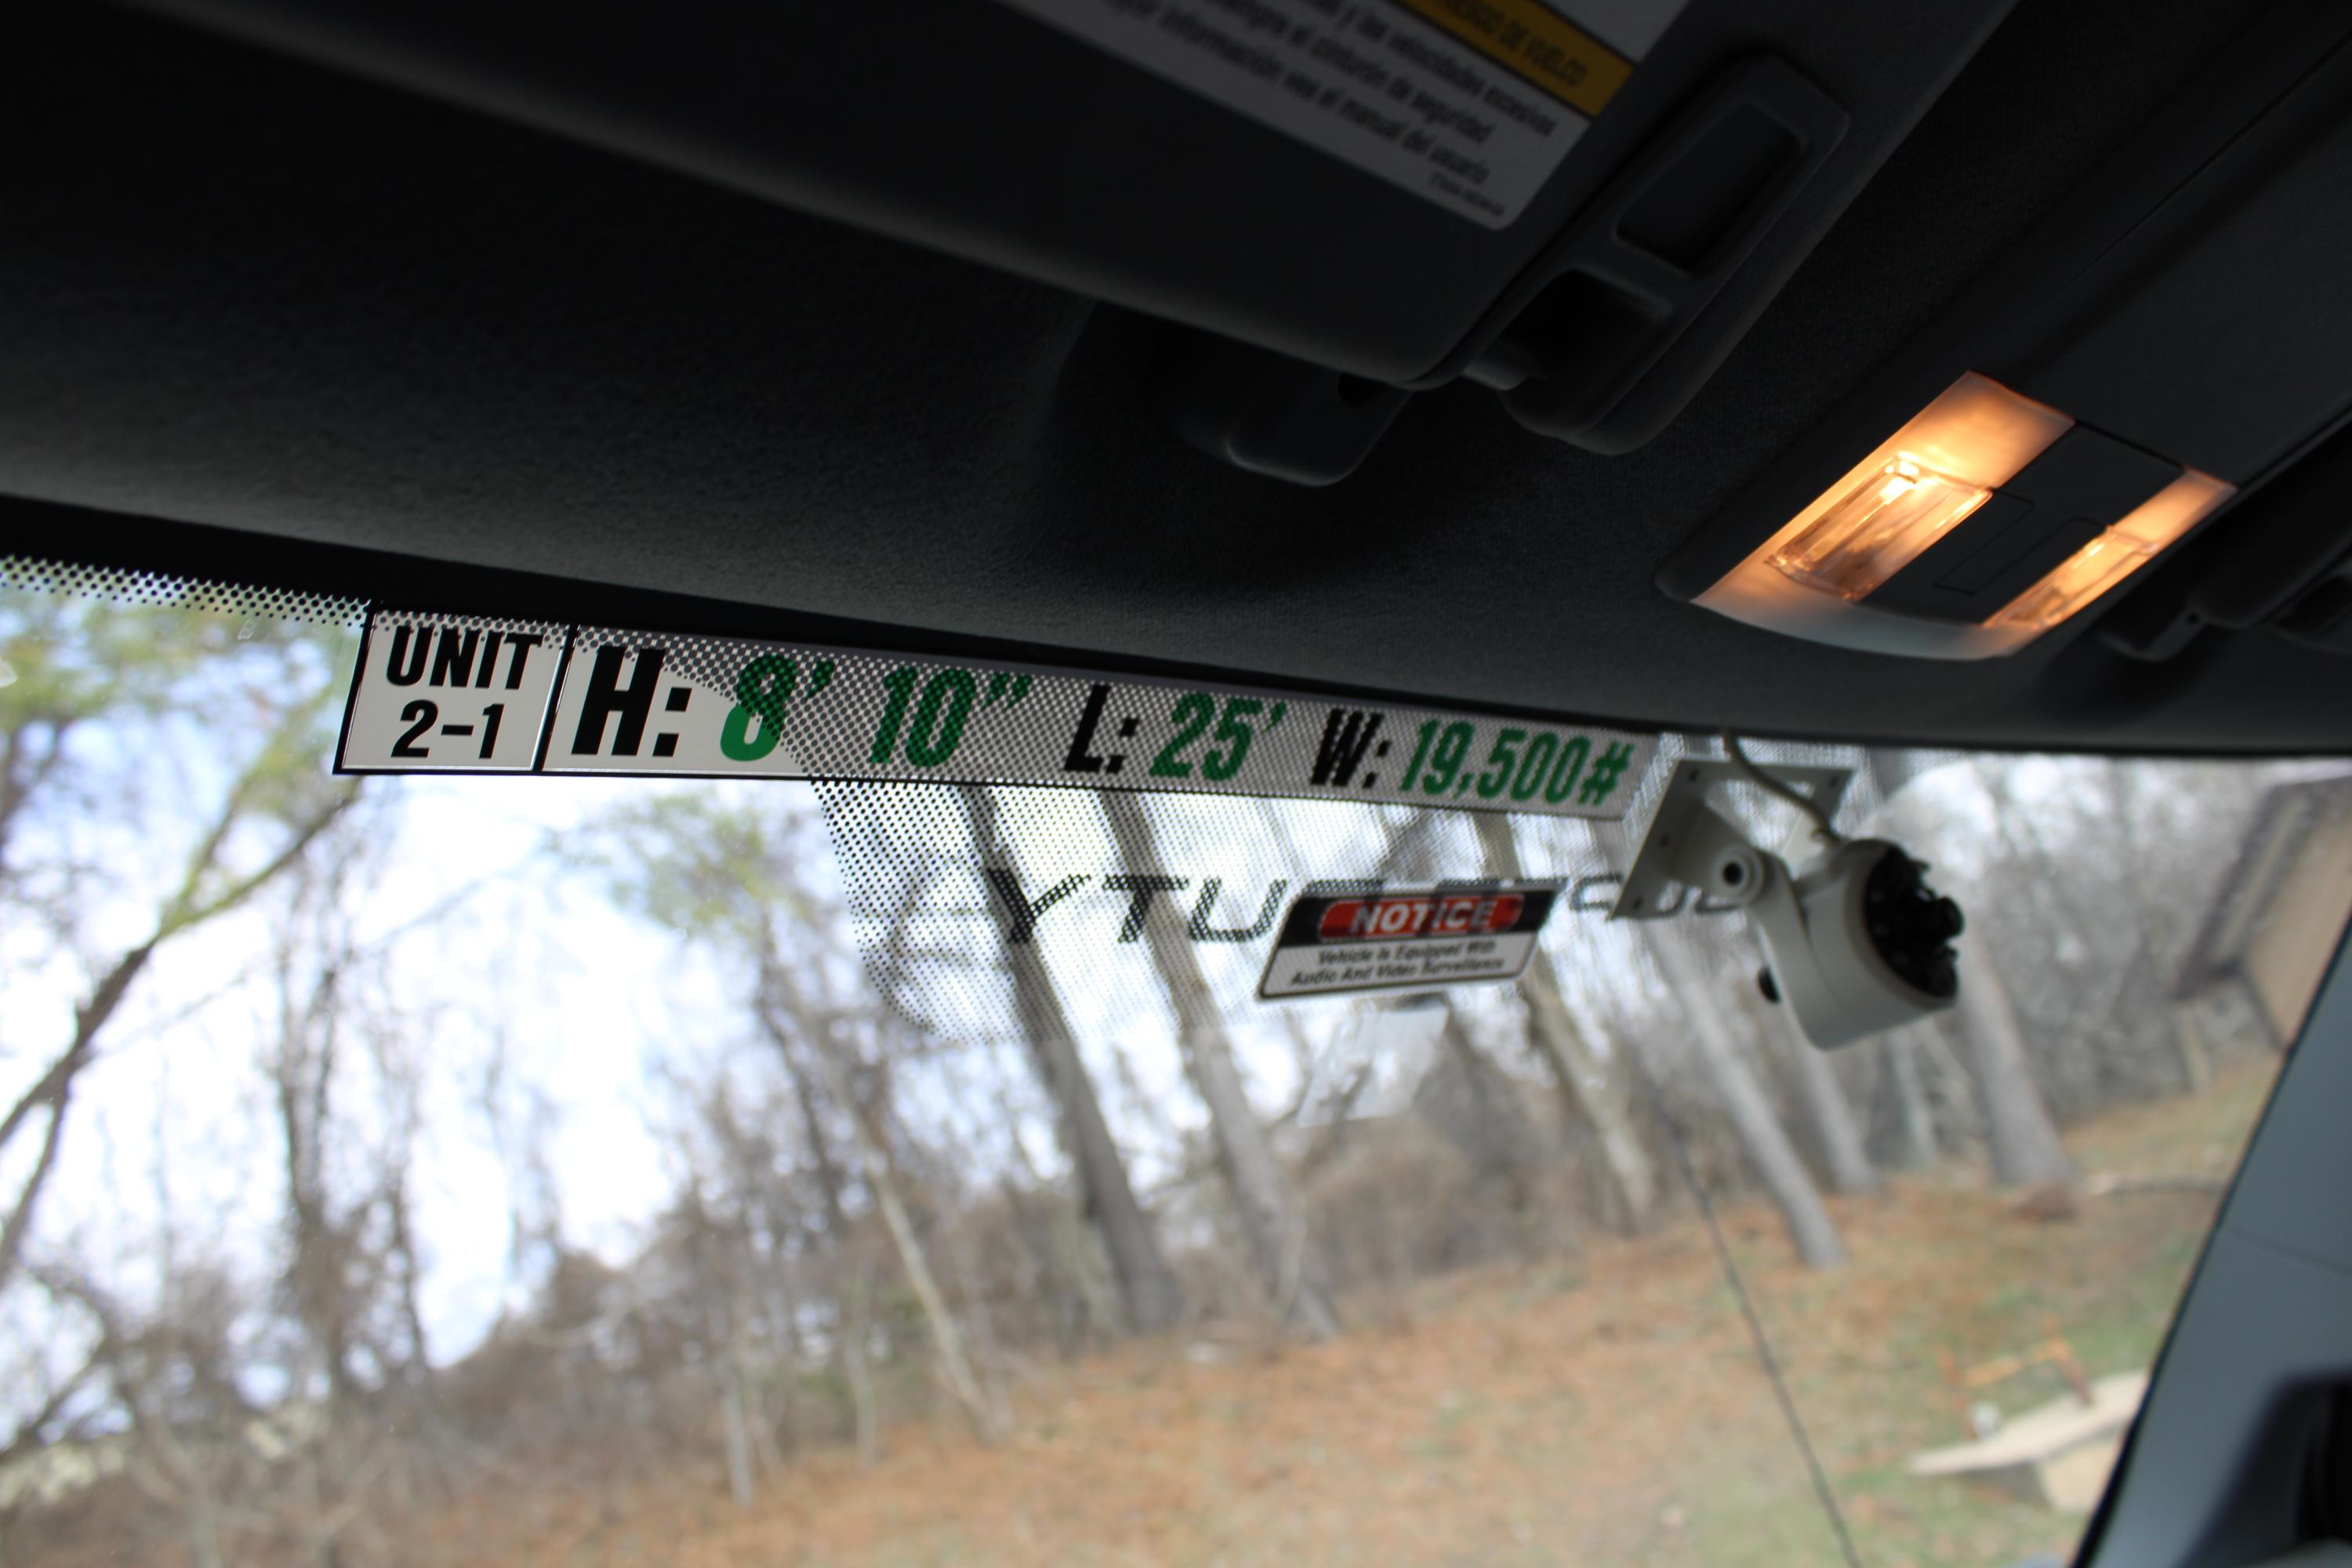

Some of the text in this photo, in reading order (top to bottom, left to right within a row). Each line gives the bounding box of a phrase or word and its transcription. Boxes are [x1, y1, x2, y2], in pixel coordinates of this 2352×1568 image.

[1387, 32, 1486, 96] velocidades
[1483, 85, 1558, 137] excesivas
[1524, 38, 1589, 87] VUELCO
[1338, 96, 1410, 142] manual
[1400, 125, 1438, 154] del
[1428, 143, 1491, 185] usuario
[1410, 89, 1497, 144] seguridad
[386, 626, 545, 690] UNIT
[390, 699, 505, 760] 2-1
[572, 645, 693, 758] H:
[1063, 684, 1140, 774] L:
[1310, 706, 1392, 789] W:
[1349, 898, 1497, 935] NOTICE
[1290, 956, 1505, 987] Audio And Video Surveillance
[1317, 946, 1373, 966] Vehicle
[1395, 942, 1462, 964] Equipped
